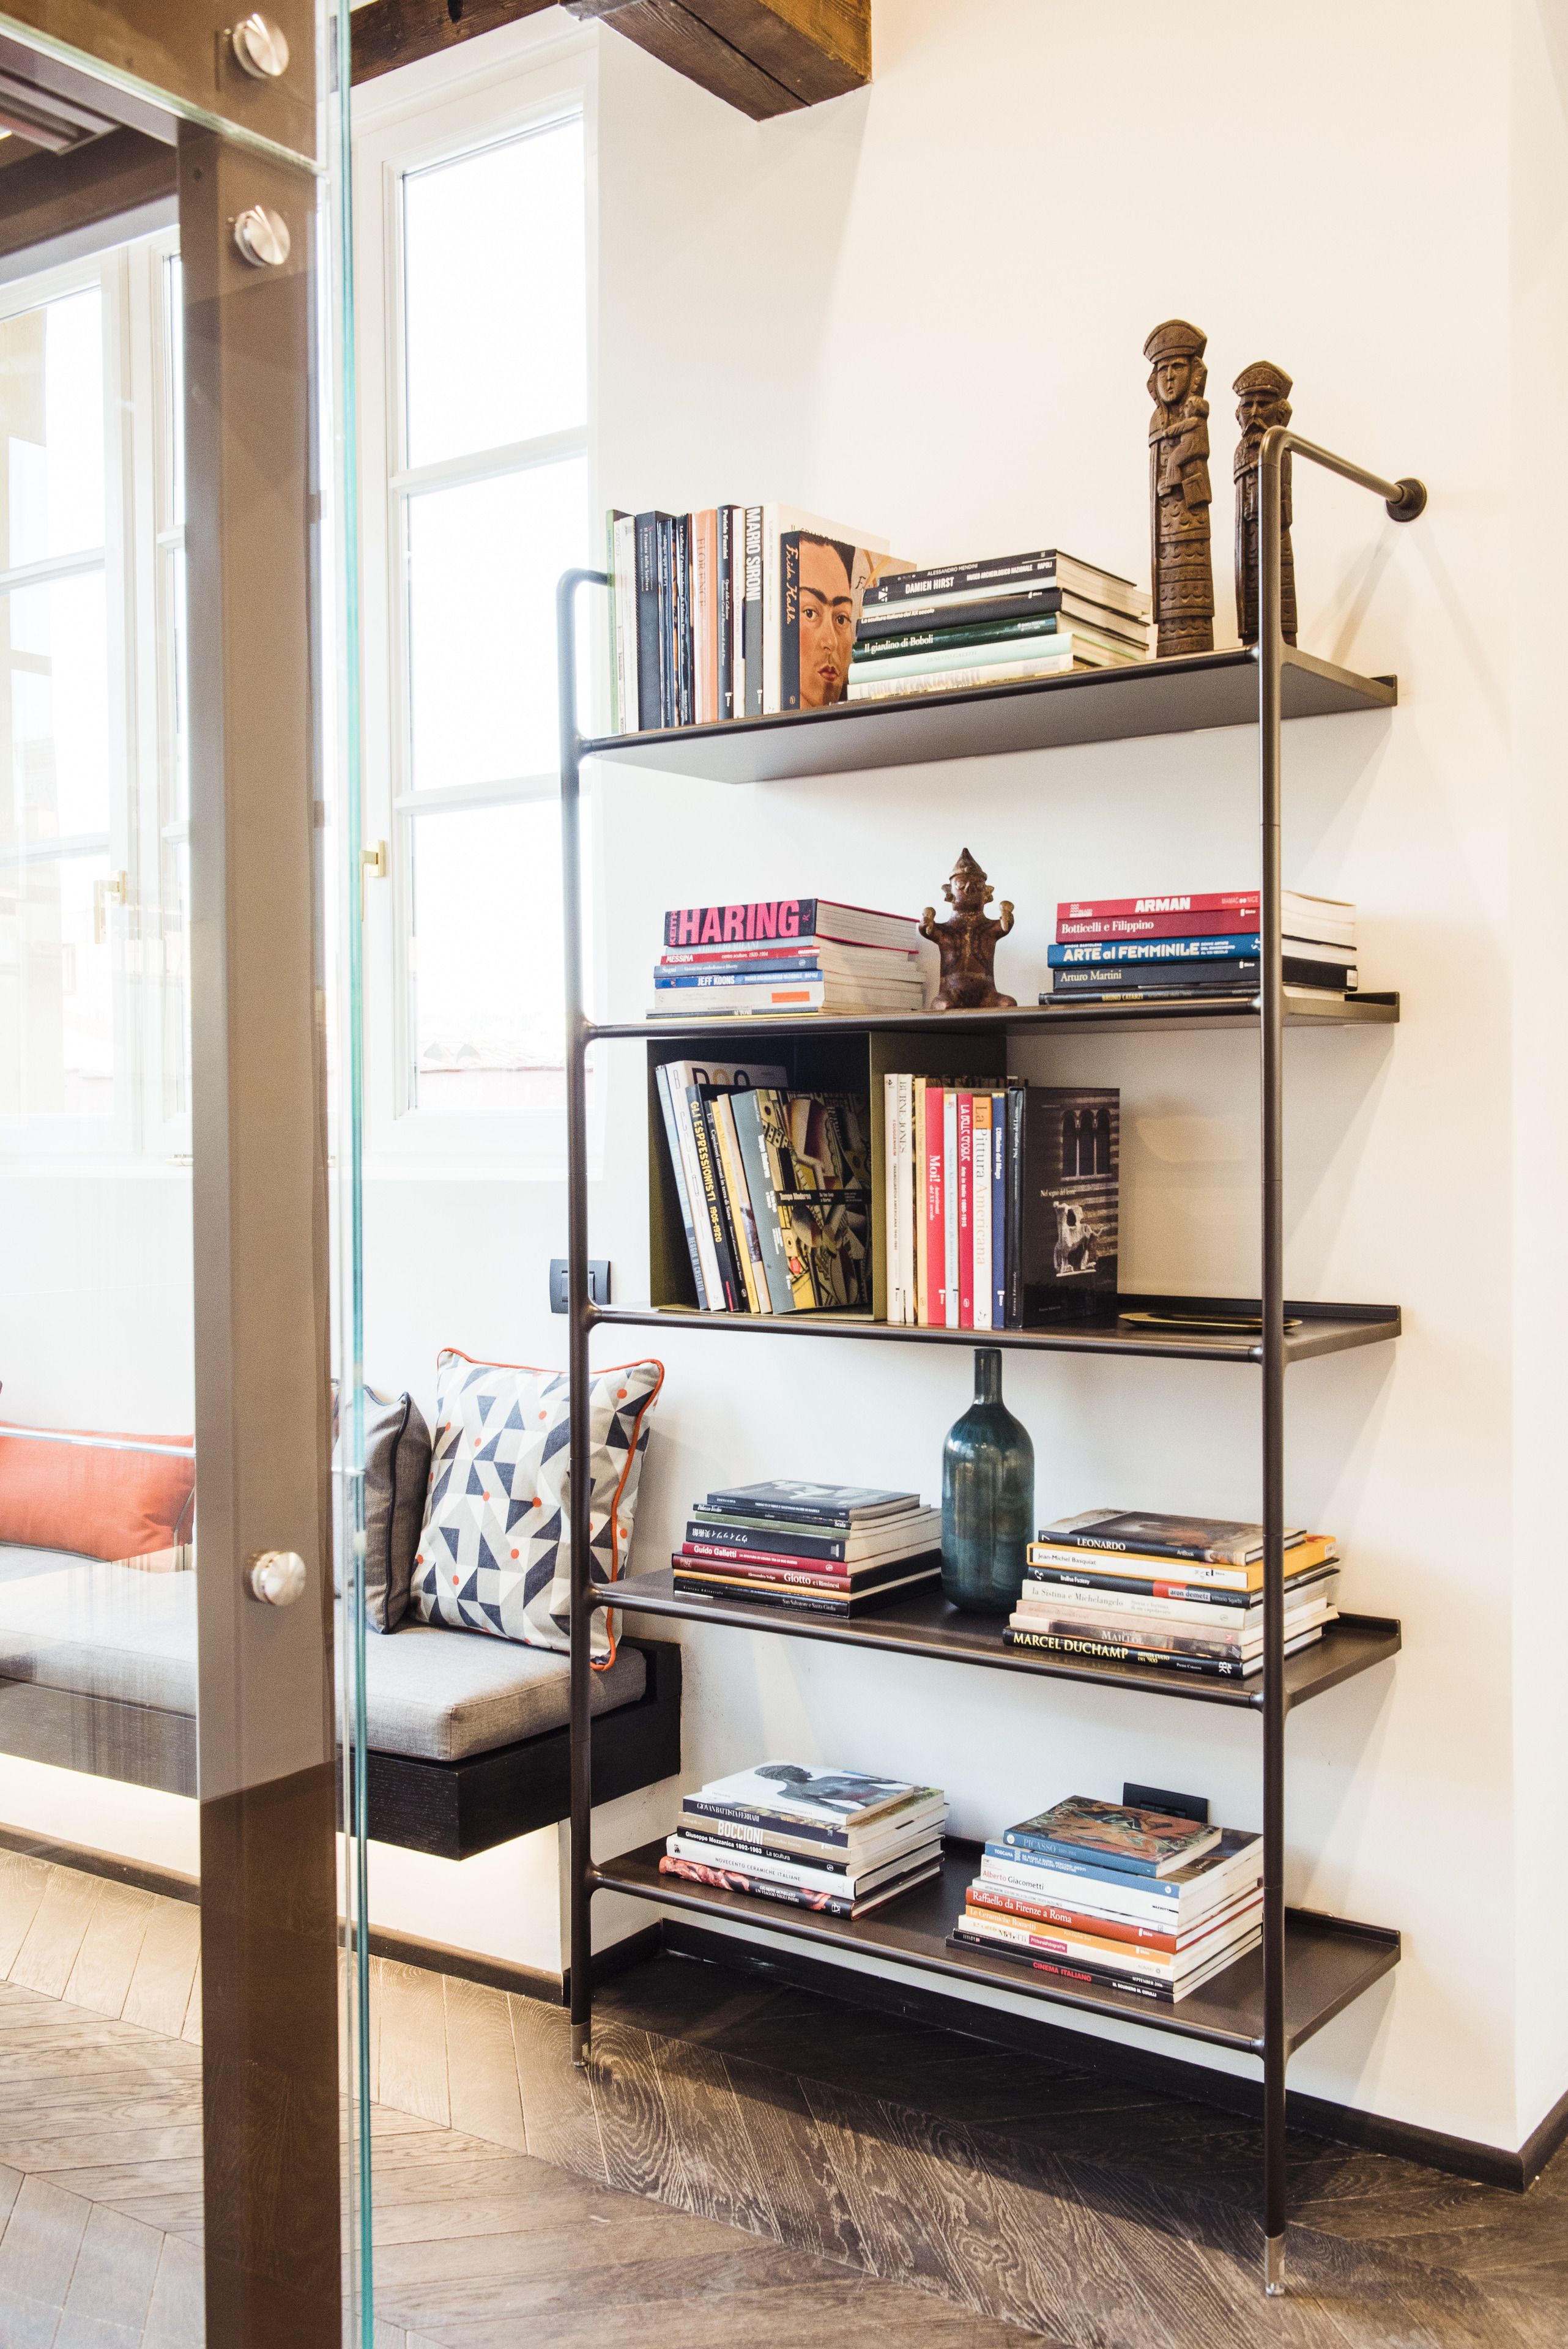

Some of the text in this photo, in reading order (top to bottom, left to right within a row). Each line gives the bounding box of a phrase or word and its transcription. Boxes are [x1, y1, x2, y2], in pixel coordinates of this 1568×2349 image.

[745, 507, 761, 601] MARIO SIRONI
[697, 538, 706, 607] FLORENCE
[905, 561, 1052, 595] DAMIEN HIRST MUSEO ARCHEOLOGICO NAZIONALE NAPOLI
[927, 562, 978, 576] ALESSANDRO MENDINI
[786, 544, 798, 625] Frida Kahlo
[864, 634, 934, 655] Il giardino di Boboli
[1134, 897, 1191, 913] ARMAN
[678, 900, 800, 945] HARING
[1061, 921, 1101, 934] Botticelli
[1112, 920, 1154, 933] Filippino
[666, 954, 694, 963] MESSINA
[1063, 942, 1200, 962] ARTE al FEMMINILE
[697, 976, 713, 986] JEFF
[713, 974, 735, 985] KOONS
[1060, 970, 1122, 982] Arturo Martini
[960, 1104, 970, 1114] LA
[715, 1110, 726, 1151] Vivian Maier
[710, 1129, 719, 1157] Capolavori
[716, 1158, 724, 1179] ritrovati
[690, 1100, 723, 1242] GLI ESPRESSIONISTI 1905-1920
[929, 1154, 941, 1182] Moi!
[975, 1105, 988, 1266] La Pittura Americana
[688, 1236, 699, 1258] REGGIA
[694, 1266, 705, 1292] CASERTA
[834, 1520, 846, 1529] Scala
[693, 1545, 737, 1559] Guido Galletti
[1077, 1537, 1126, 1551] LEONARDO
[1038, 1552, 1096, 1567] Jean-Michel Basquiat
[783, 1572, 811, 1585] Giotto
[819, 1580, 840, 1589] Riminesi
[1032, 1586, 1039, 1595] la
[1041, 1588, 1066, 1600] Sistina
[1074, 1592, 1124, 1608] Michelangelo
[1185, 1590, 1209, 1600] demetz
[1013, 1631, 1129, 1660] MARCEL DUCHAMP
[1101, 1630, 1145, 1645] MAILLOL
[696, 1802, 760, 1822] GIOVAN BATTISTA FERRARI
[718, 1819, 764, 1845] BOCCIONI
[685, 1830, 708, 1842] Giuseppe
[708, 1835, 735, 1847] Mozzanica
[735, 1842, 762, 1854] 1892-1983
[773, 1851, 790, 1861] scultura
[994, 1849, 1013, 1858] TOSCANA
[1023, 1838, 1057, 1853] PICASSO
[715, 1857, 801, 1882] NOVECENTO CERAMICHE ITALIANE
[982, 1869, 1044, 1891] Alberto Giacometti
[972, 1891, 1003, 1907] Raffaello
[1005, 1898, 1014, 1910] da
[1015, 1902, 1041, 1917] Firenze
[1049, 1910, 1072, 1924] Roma
[970, 1907, 978, 1916] Le
[978, 1910, 1011, 1924] Ceramiche
[1011, 1918, 1036, 1931] Rometti
[1033, 1962, 1092, 1982] CINEMA ITALIANO
[1132, 1976, 1154, 1986] SEPTEMBER
[1117, 1983, 1157, 1998] SCUDIERO CIRULLI
